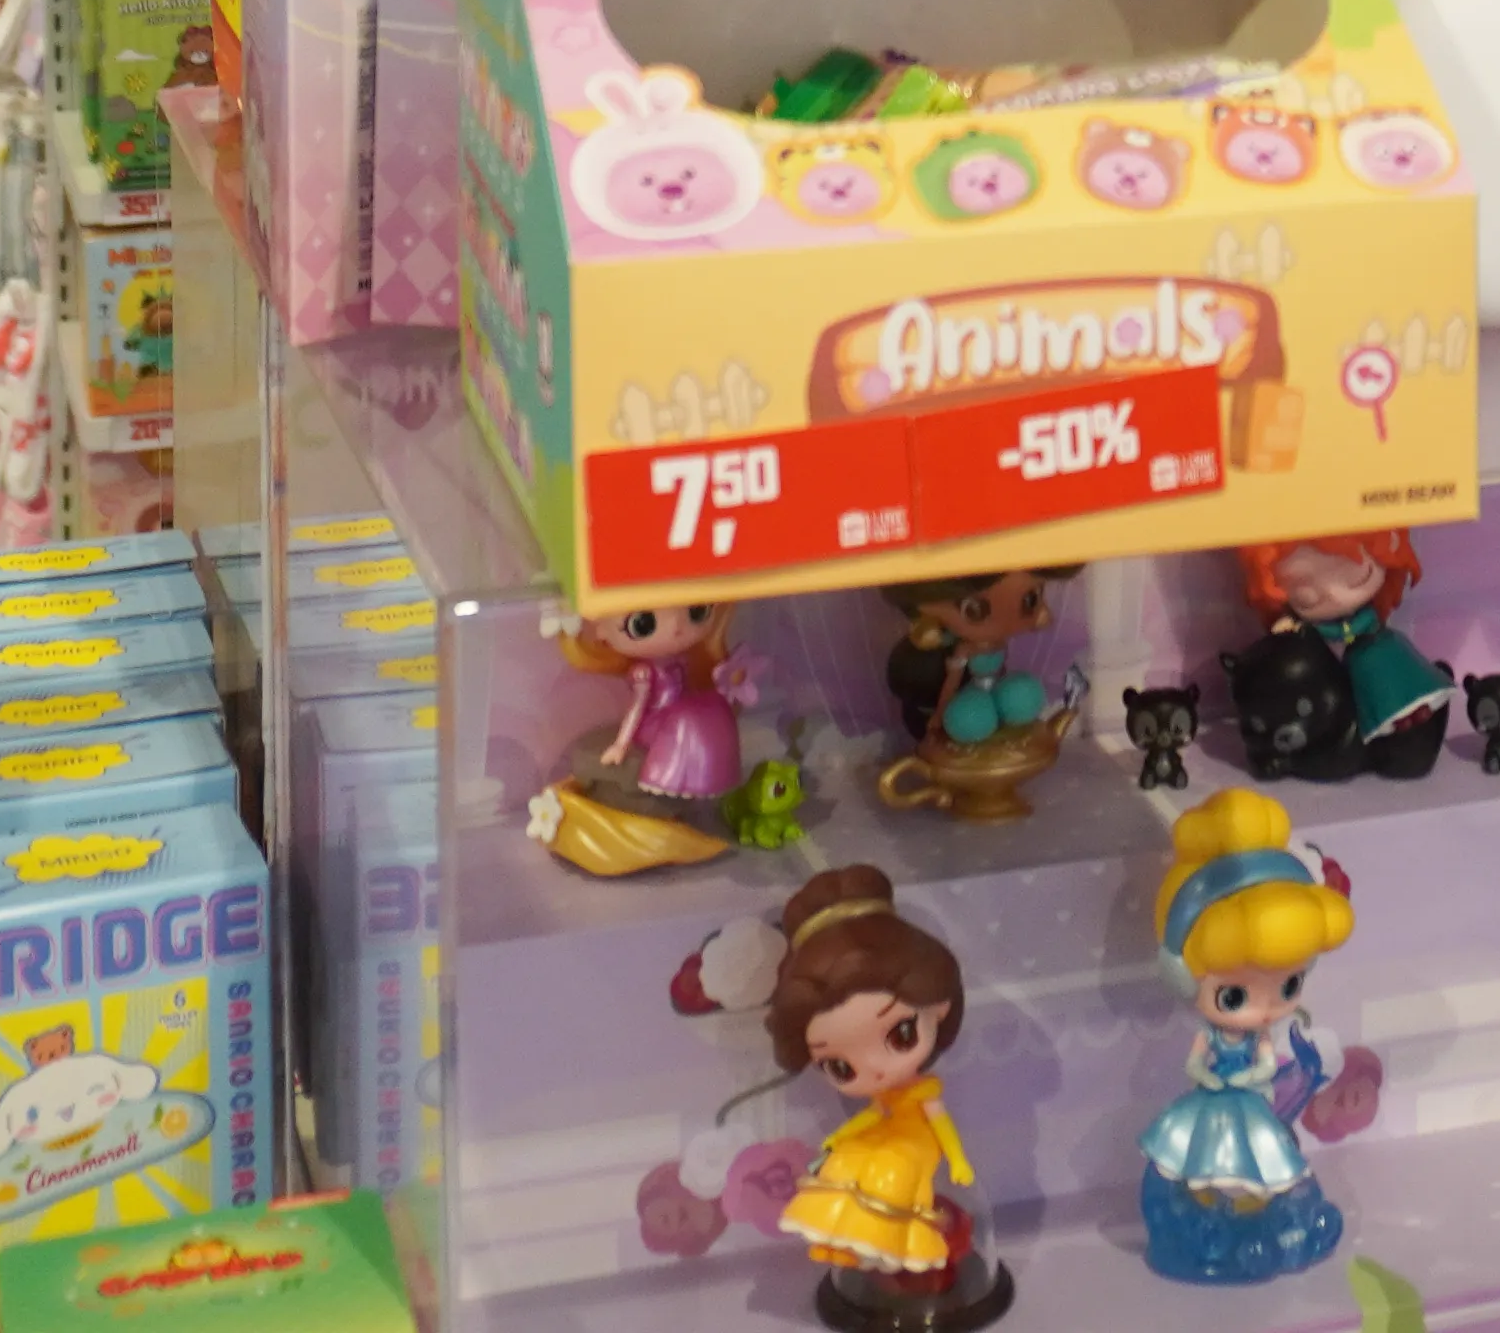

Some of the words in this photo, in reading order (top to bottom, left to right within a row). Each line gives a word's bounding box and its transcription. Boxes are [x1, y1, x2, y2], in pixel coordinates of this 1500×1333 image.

[877, 279, 1226, 393] Animals
[999, 400, 1140, 482] -50%
[650, 445, 781, 557] 7,50
[26, 1133, 142, 1194] Cinnamoroll
